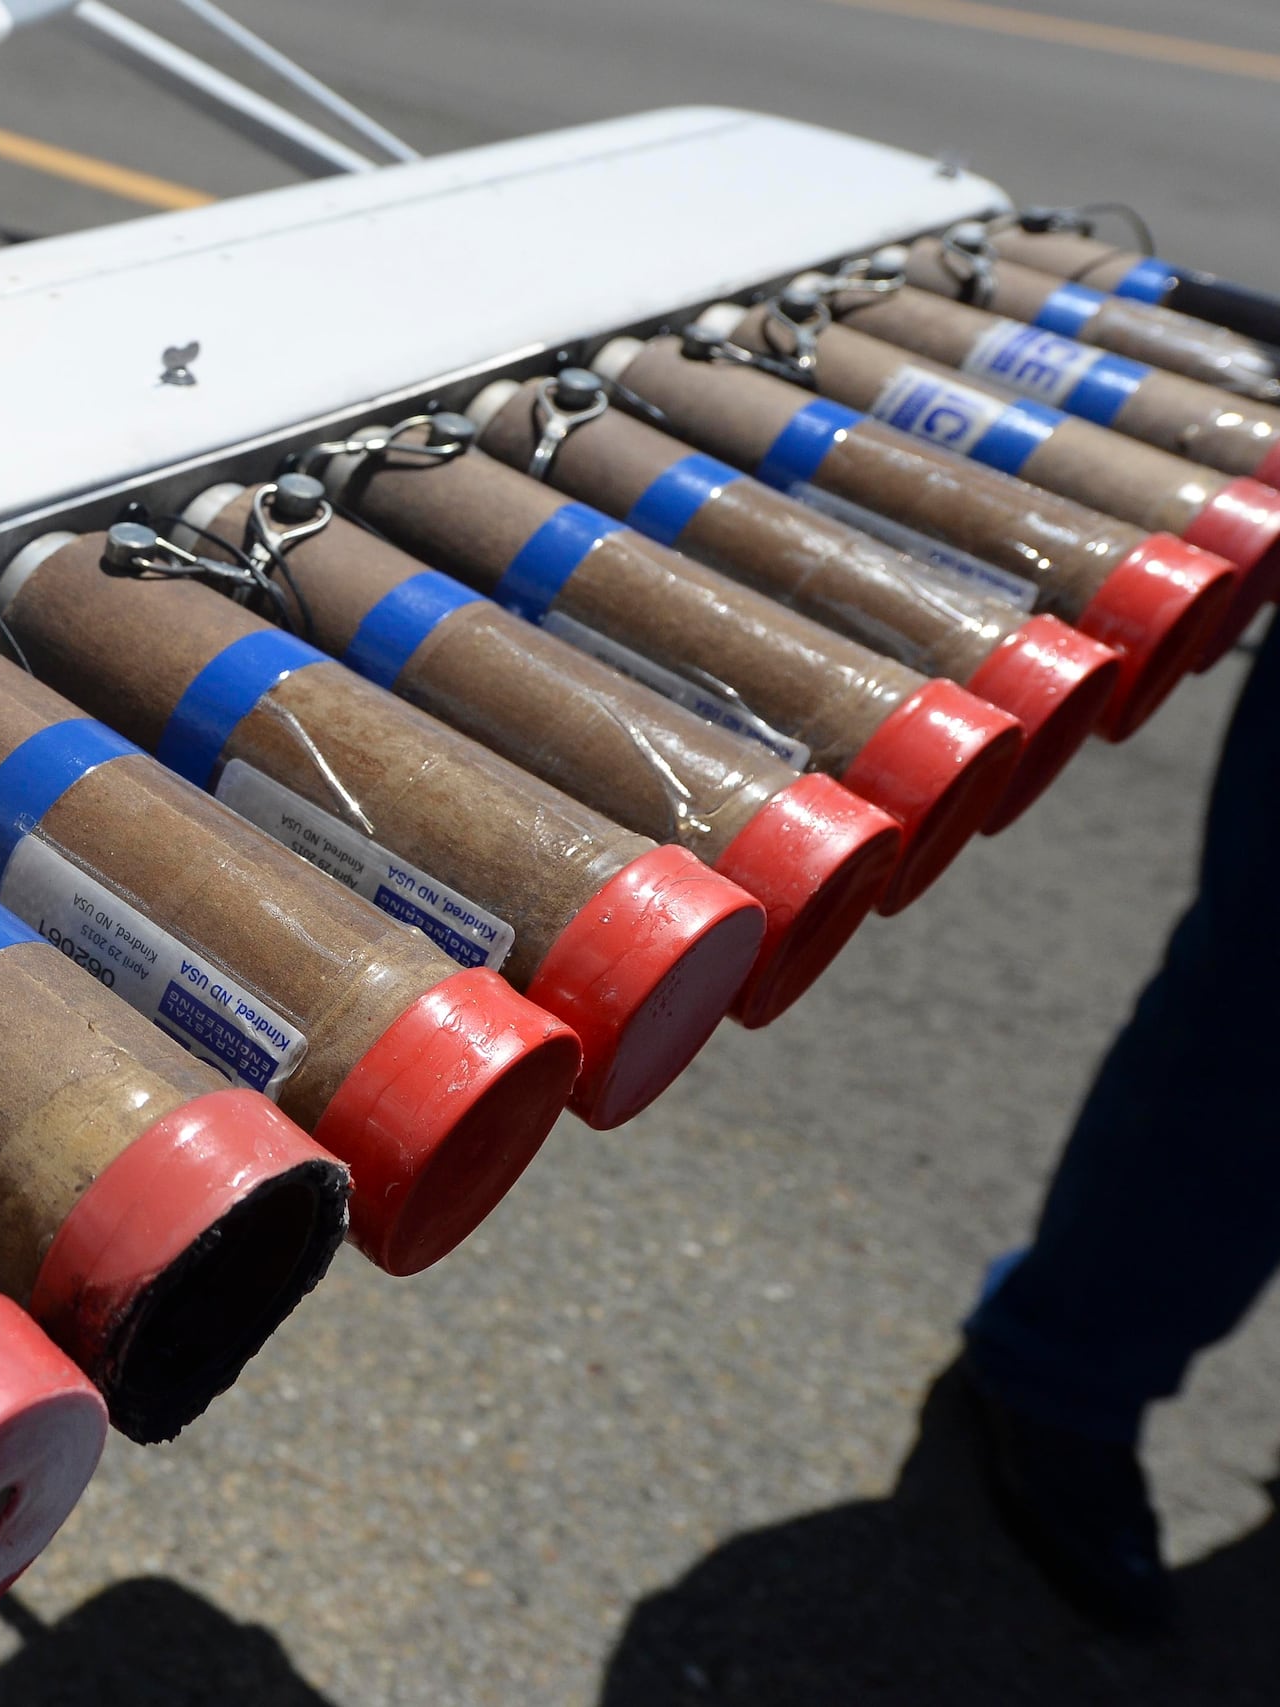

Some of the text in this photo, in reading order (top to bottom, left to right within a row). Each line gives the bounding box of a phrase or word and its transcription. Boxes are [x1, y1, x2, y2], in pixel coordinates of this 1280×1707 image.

[1017, 337, 1080, 391] CE
[924, 394, 981, 442] IC
[281, 813, 365, 874] Kindred, ND USA
[388, 866, 417, 893] USA
[418, 886, 440, 907] ND
[74, 893, 158, 963] Kindred, ND USA
[442, 896, 498, 942] Kindred,
[81, 924, 150, 980] April 29 2015
[179, 960, 210, 990] USA
[210, 983, 233, 1006] ND
[167, 999, 237, 1060] CRYSTAL
[169, 989, 271, 1073] ENGINEERING
[235, 998, 291, 1052] Kindred,
[239, 1058, 267, 1084] ICE
